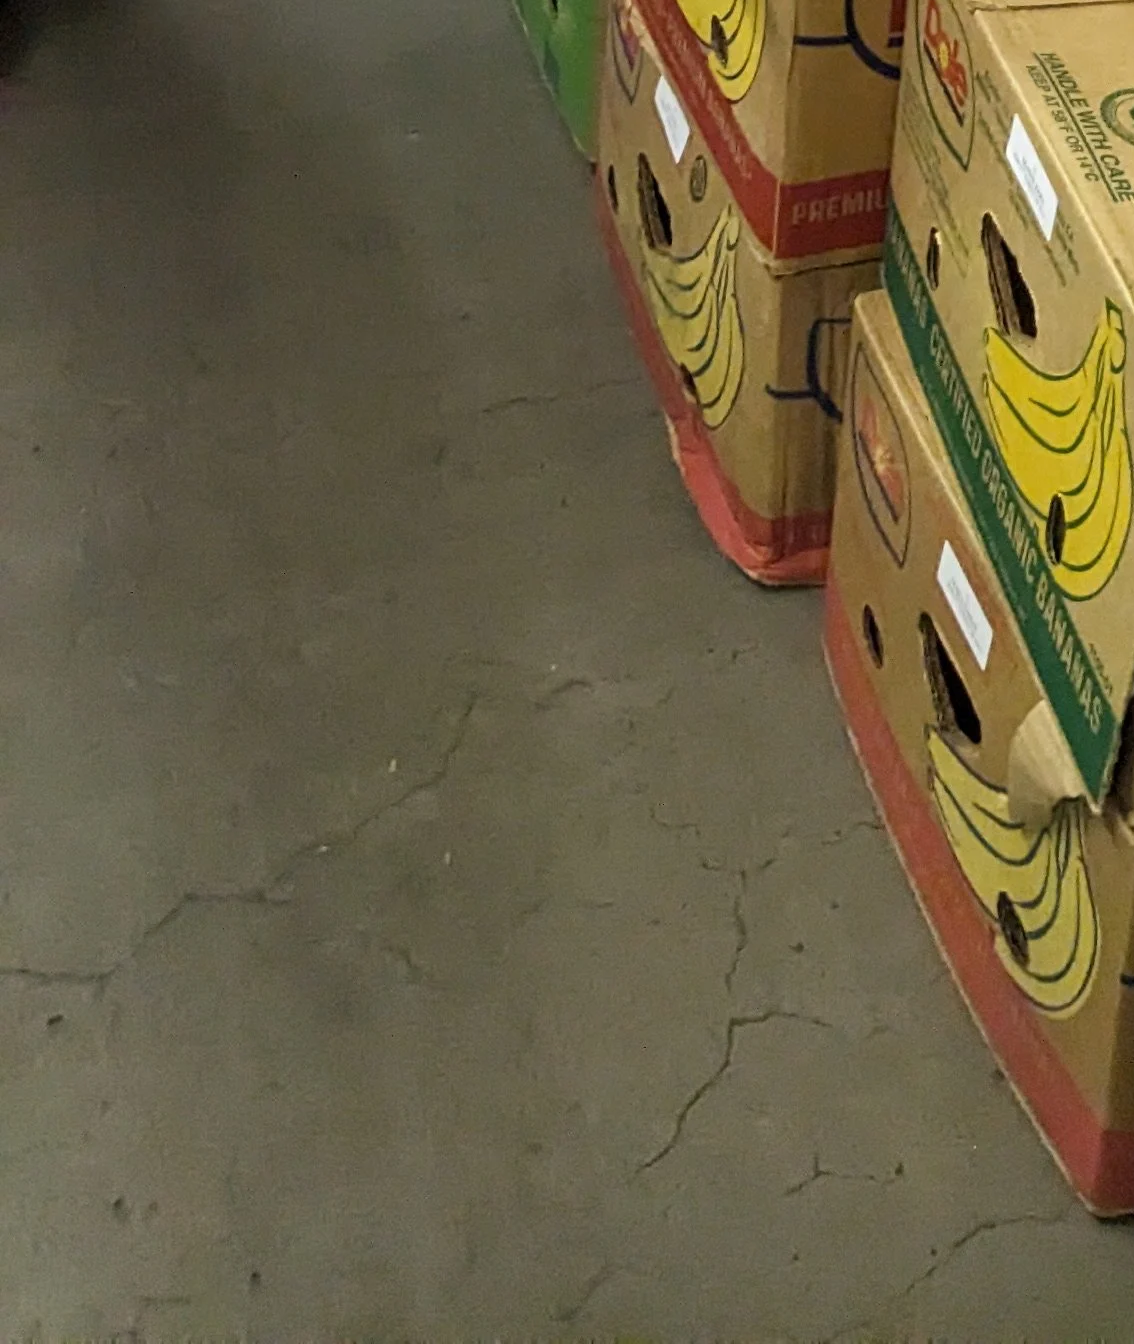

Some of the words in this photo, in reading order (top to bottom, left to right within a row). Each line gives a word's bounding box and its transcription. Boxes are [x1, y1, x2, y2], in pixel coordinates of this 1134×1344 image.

[1026, 65, 1051, 93] KEEP
[1042, 94, 1059, 107] AT
[1065, 135, 1084, 153] OR
[1040, 52, 1088, 109] HANDLE
[1076, 110, 1113, 151] WITH
[792, 186, 887, 226] PREMIU
[929, 329, 981, 460] CERTIFIED
[980, 456, 1038, 587] ORGANIC
[1034, 572, 1104, 736] BANANAS
